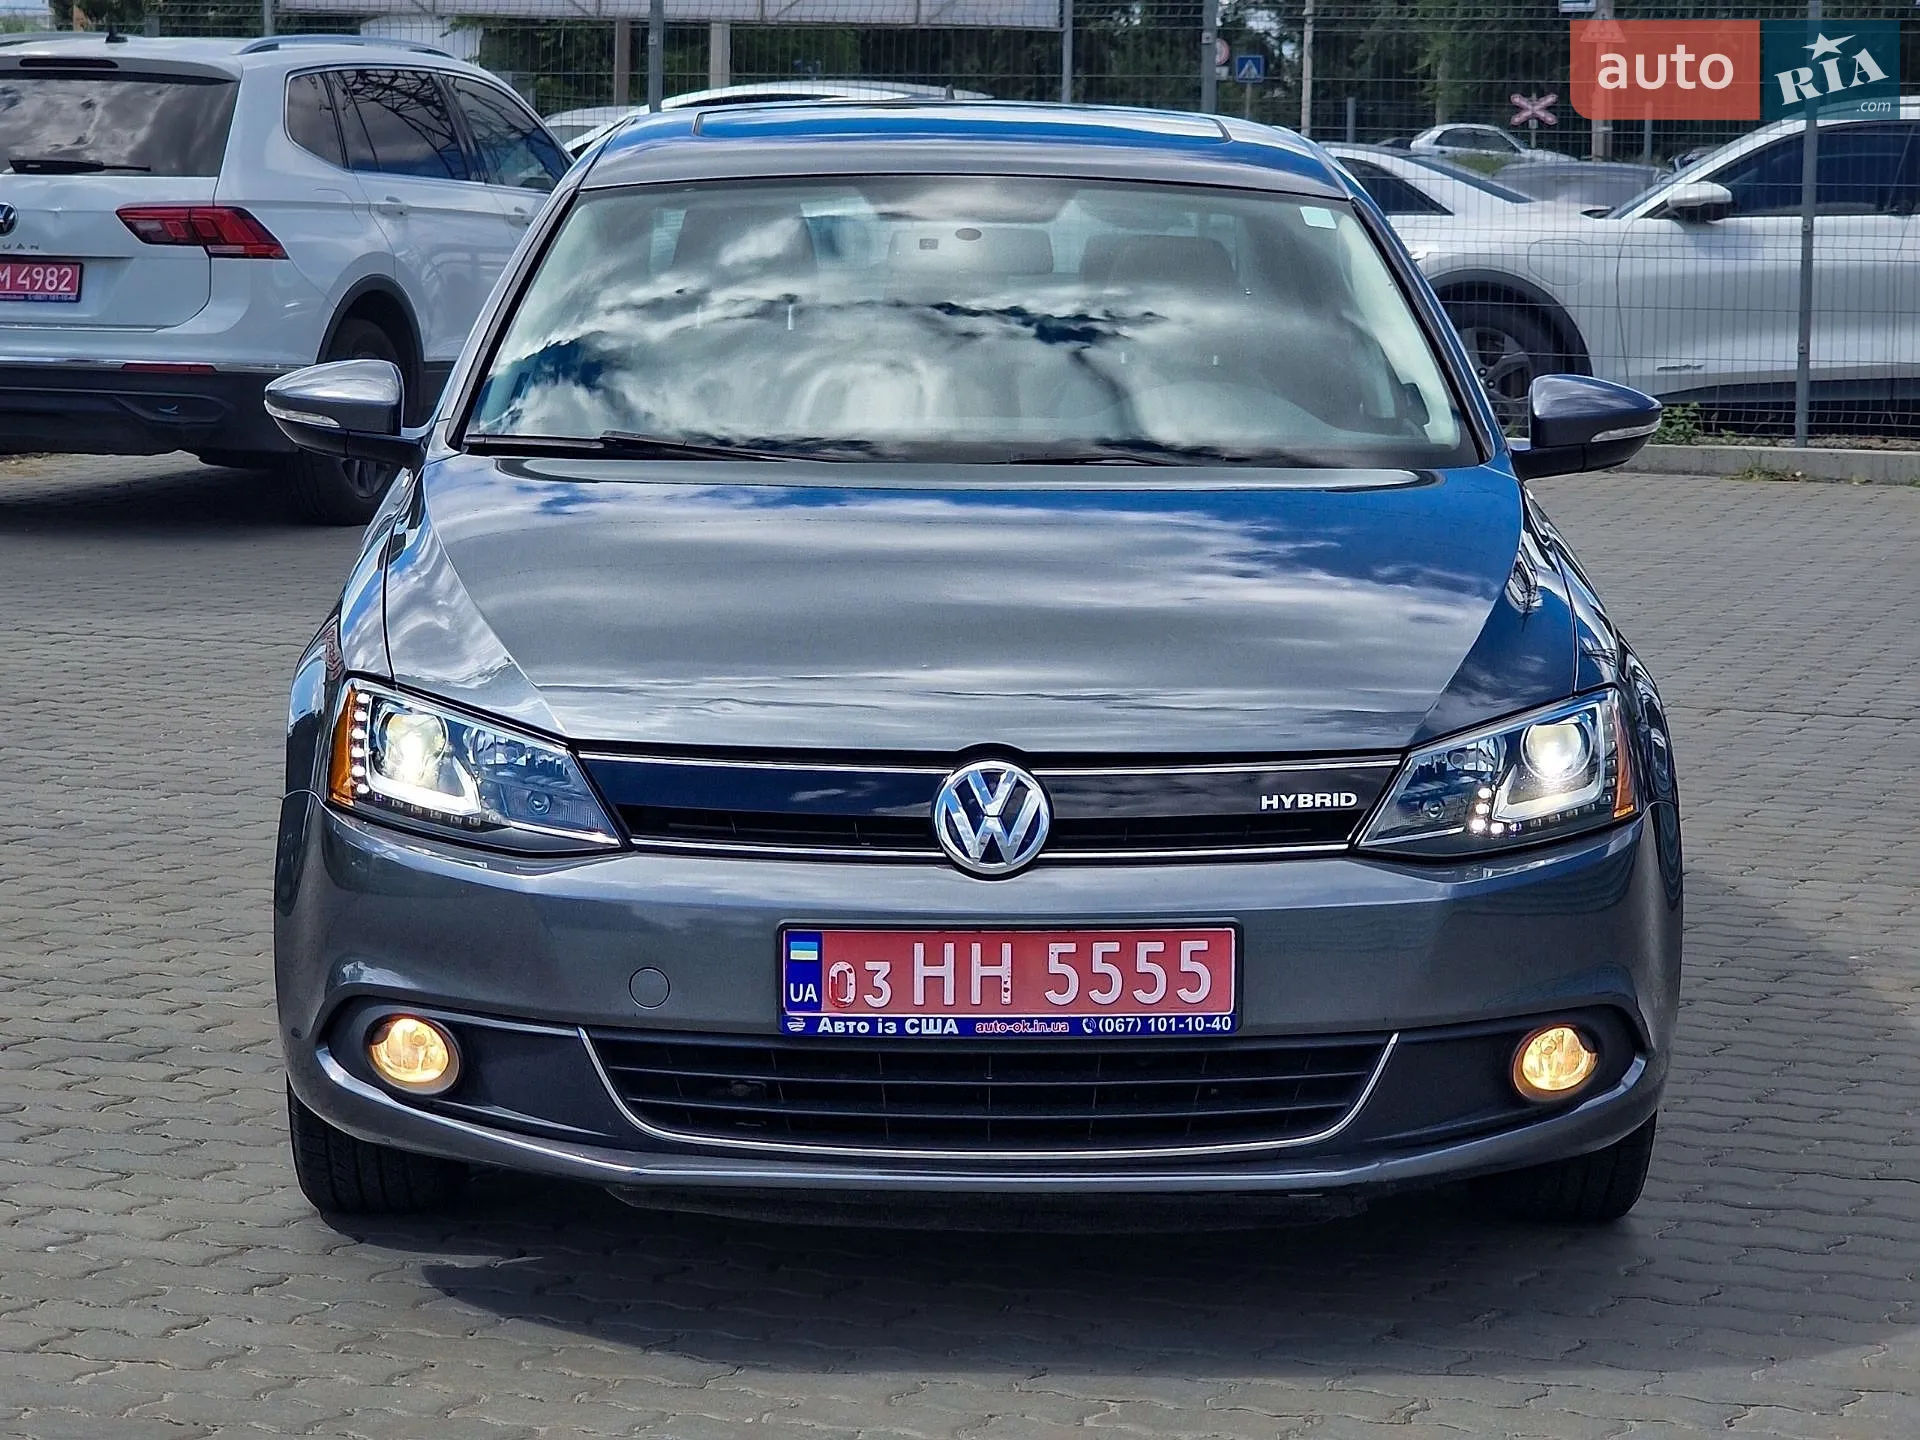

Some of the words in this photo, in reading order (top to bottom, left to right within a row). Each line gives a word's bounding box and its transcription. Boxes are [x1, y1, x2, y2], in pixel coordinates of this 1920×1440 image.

[17, 266, 73, 291] 4982
[1261, 792, 1358, 810] HYBRID
[828, 961, 893, 1008] 03
[1044, 940, 1212, 1006] 5555
[790, 983, 818, 1003] UA
[817, 1018, 870, 1034] Авто
[877, 1018, 898, 1034] із
[904, 1018, 959, 1035] США
[975, 1020, 1070, 1034] auto-ok.in.ua
[1099, 1017, 1142, 1033] (067)
[1148, 1016, 1232, 1032] 101-10-40
